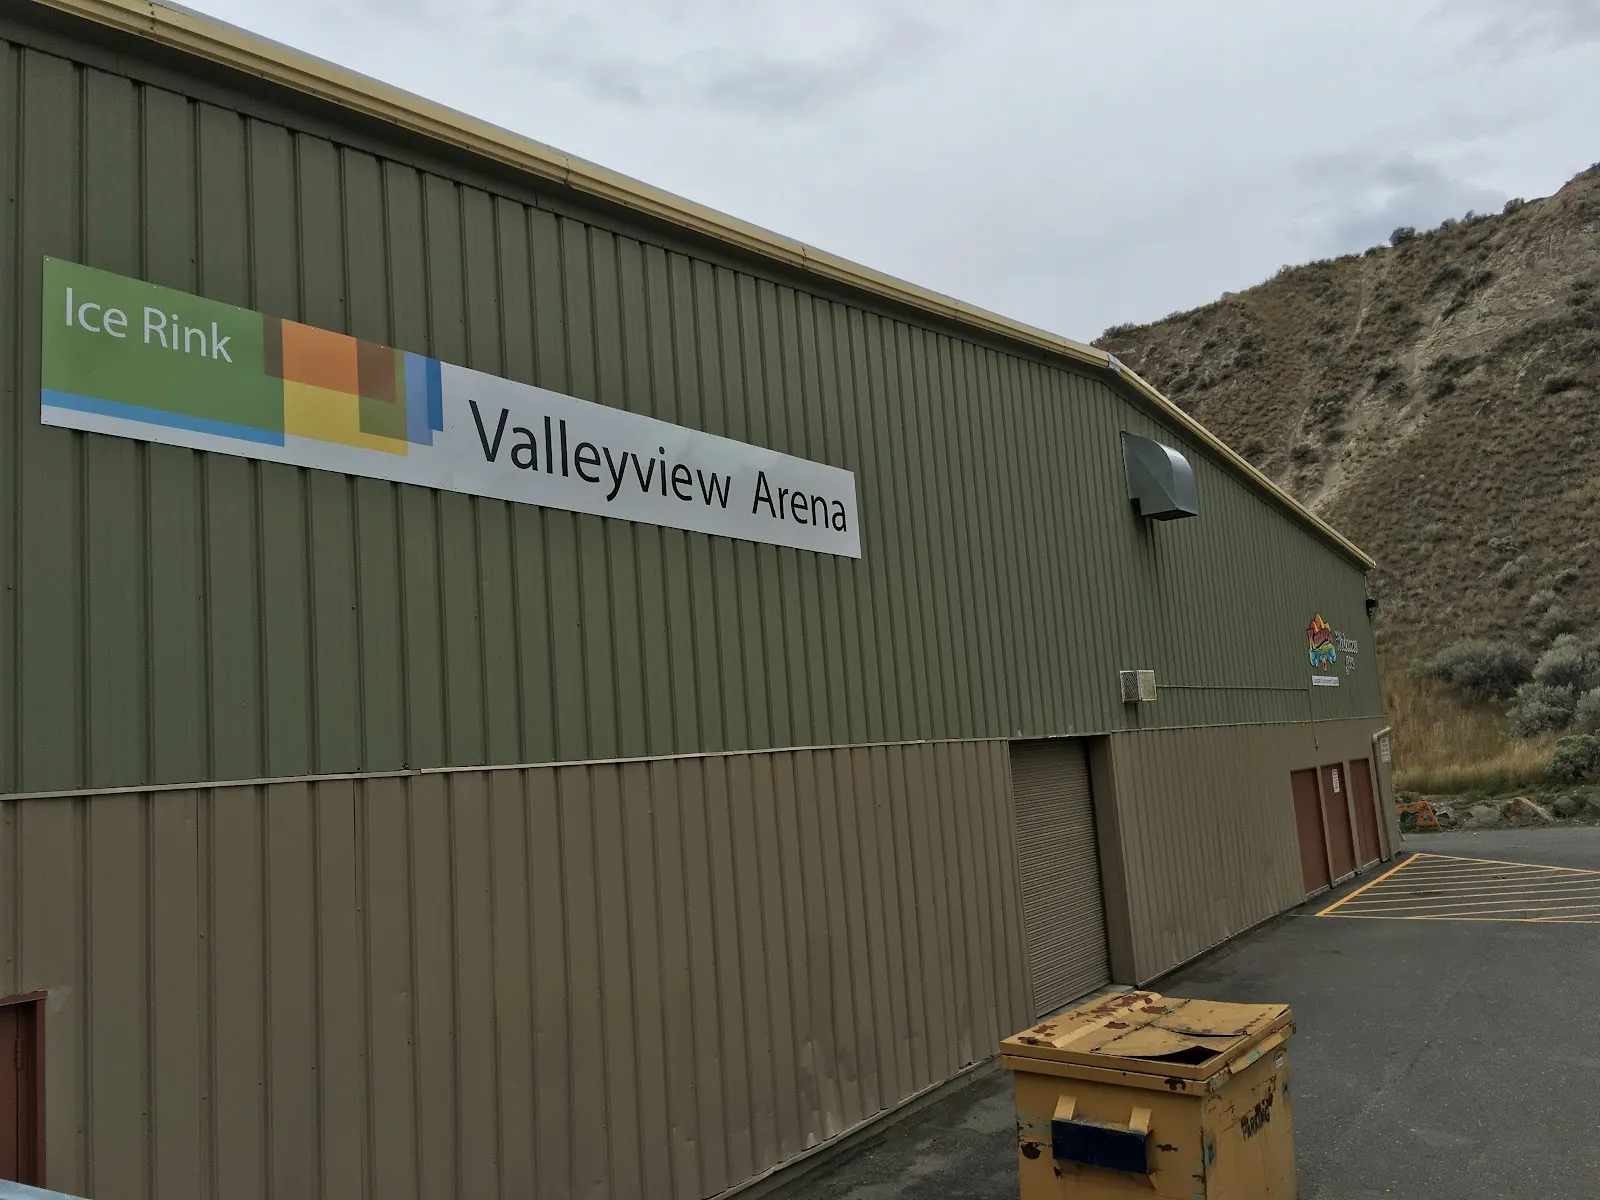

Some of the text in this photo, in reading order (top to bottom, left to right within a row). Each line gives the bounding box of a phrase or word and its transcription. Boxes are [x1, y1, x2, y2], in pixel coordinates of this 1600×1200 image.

[65, 286, 233, 363] Ice Rink
[468, 399, 848, 533] Valleyview Arena
